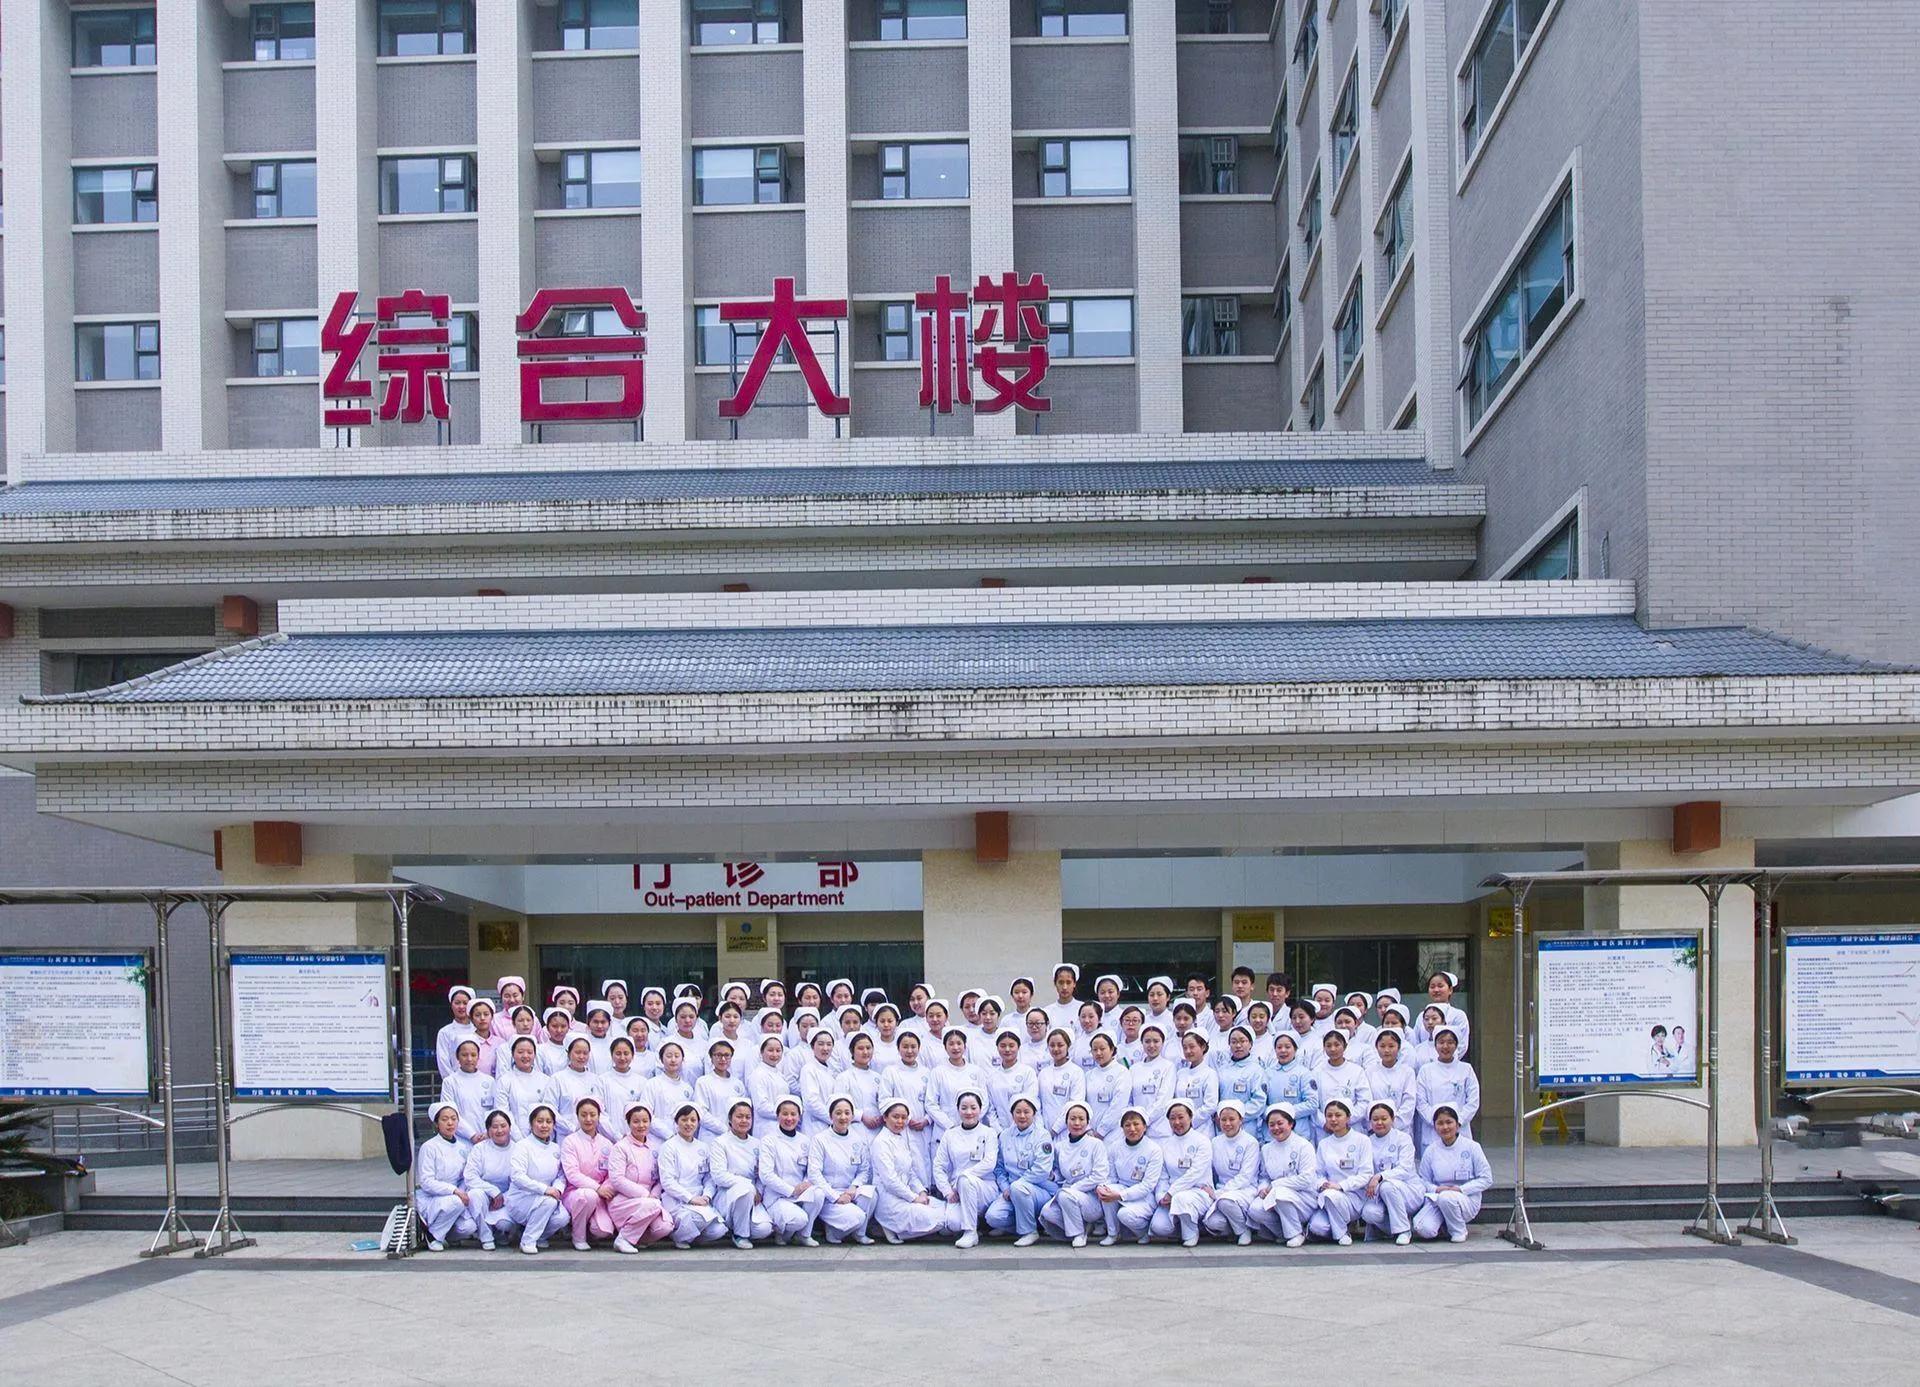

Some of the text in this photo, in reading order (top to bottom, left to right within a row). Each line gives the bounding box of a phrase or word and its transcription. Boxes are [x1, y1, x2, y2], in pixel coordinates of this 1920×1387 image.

[321, 272, 1052, 429] 综合大楼
[633, 862, 860, 889] 门诊部
[644, 890, 845, 910] Out-patient Department
